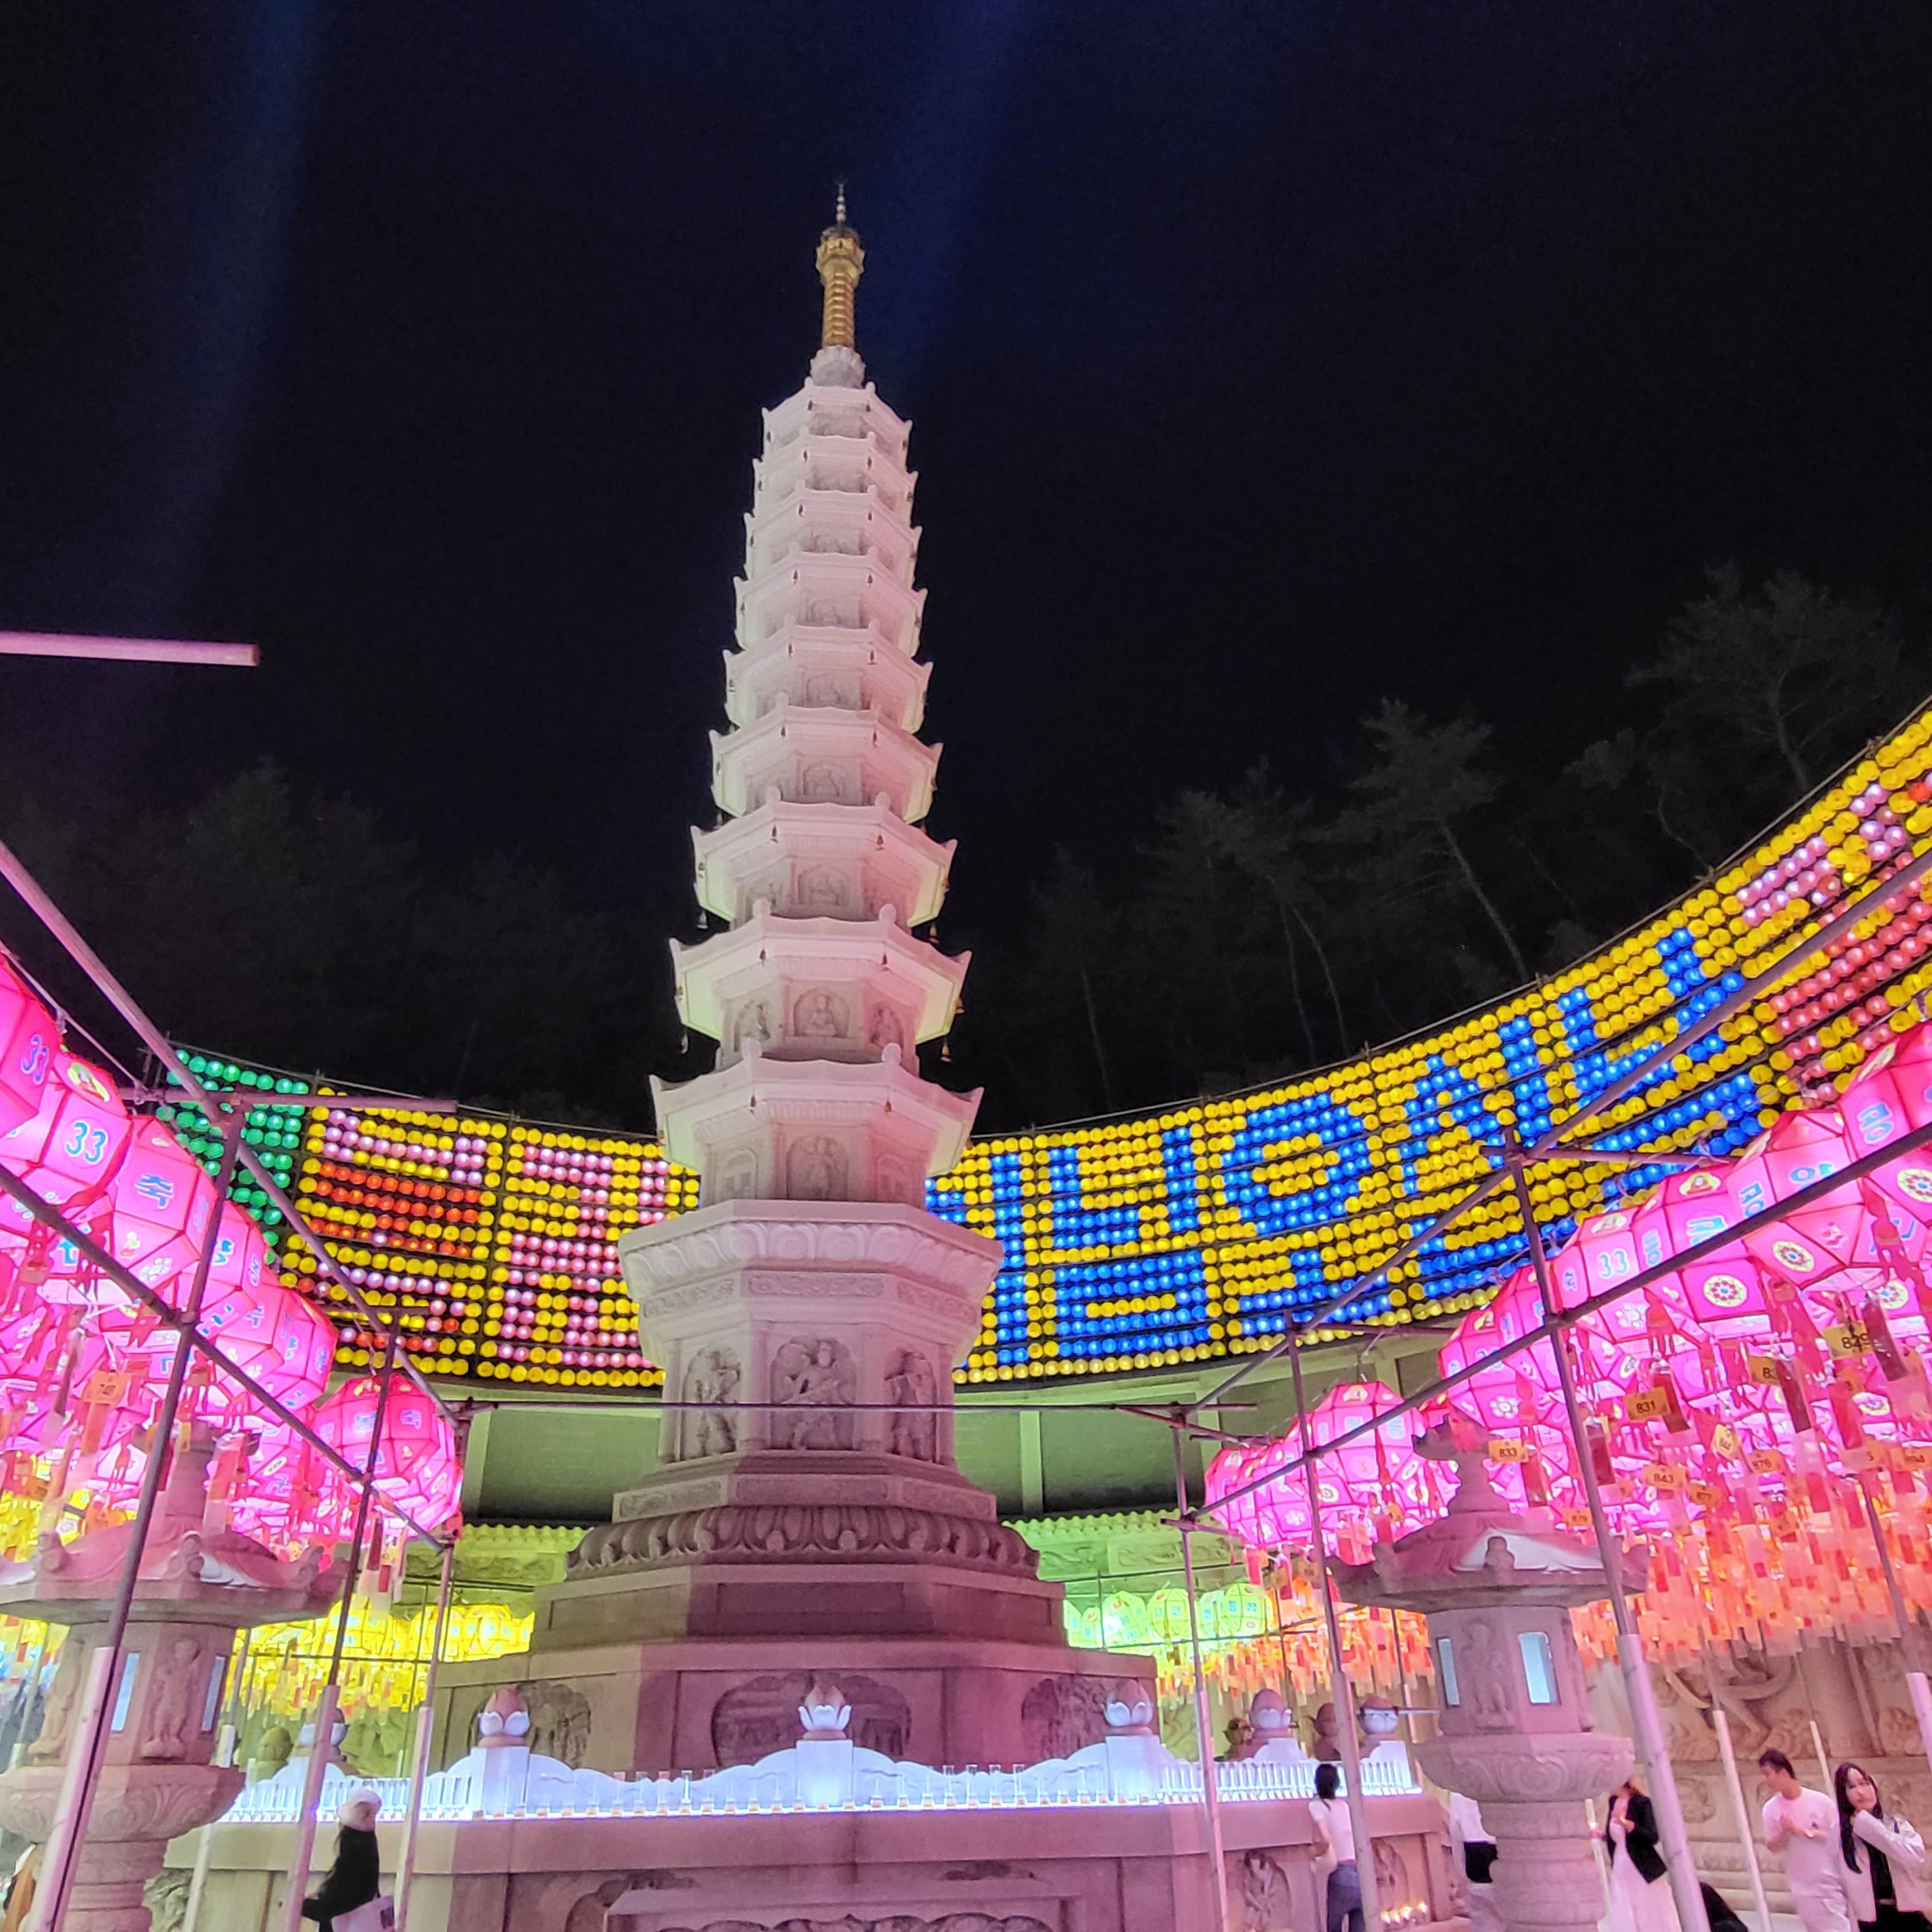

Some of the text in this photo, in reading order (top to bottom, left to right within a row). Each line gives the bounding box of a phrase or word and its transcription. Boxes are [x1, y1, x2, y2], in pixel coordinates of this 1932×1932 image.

[22, 1035, 48, 1083] 33
[66, 1121, 106, 1163] 33
[1598, 1250, 1629, 1279] 33
[1636, 1401, 1656, 1413] 831
[1499, 1447, 1517, 1458] 833
